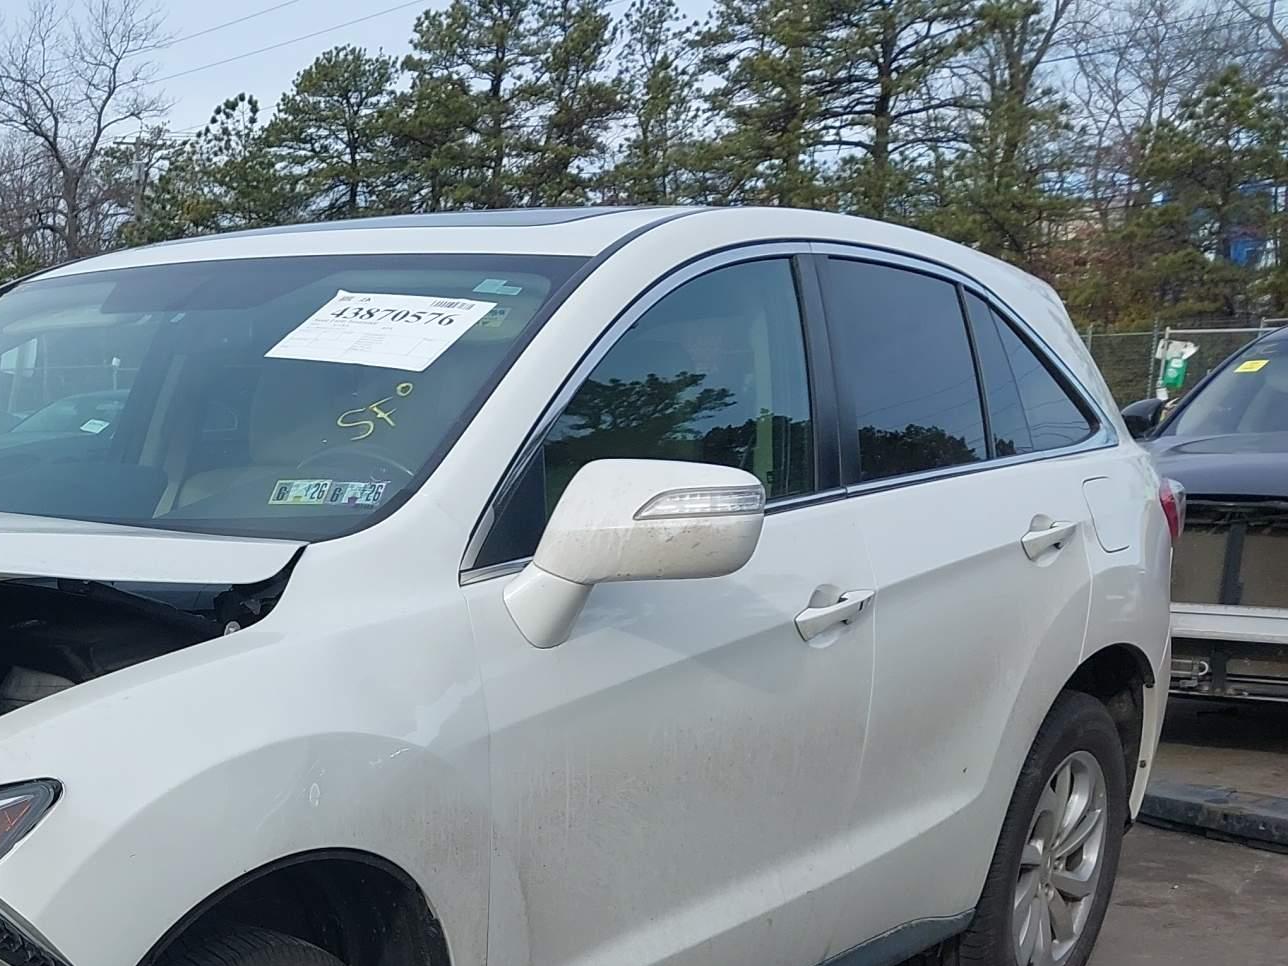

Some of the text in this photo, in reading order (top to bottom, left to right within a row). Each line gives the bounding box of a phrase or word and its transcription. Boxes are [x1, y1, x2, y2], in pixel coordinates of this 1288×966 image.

[330, 306, 461, 327] 43870576
[310, 483, 328, 500] 26
[366, 484, 384, 502] 26
